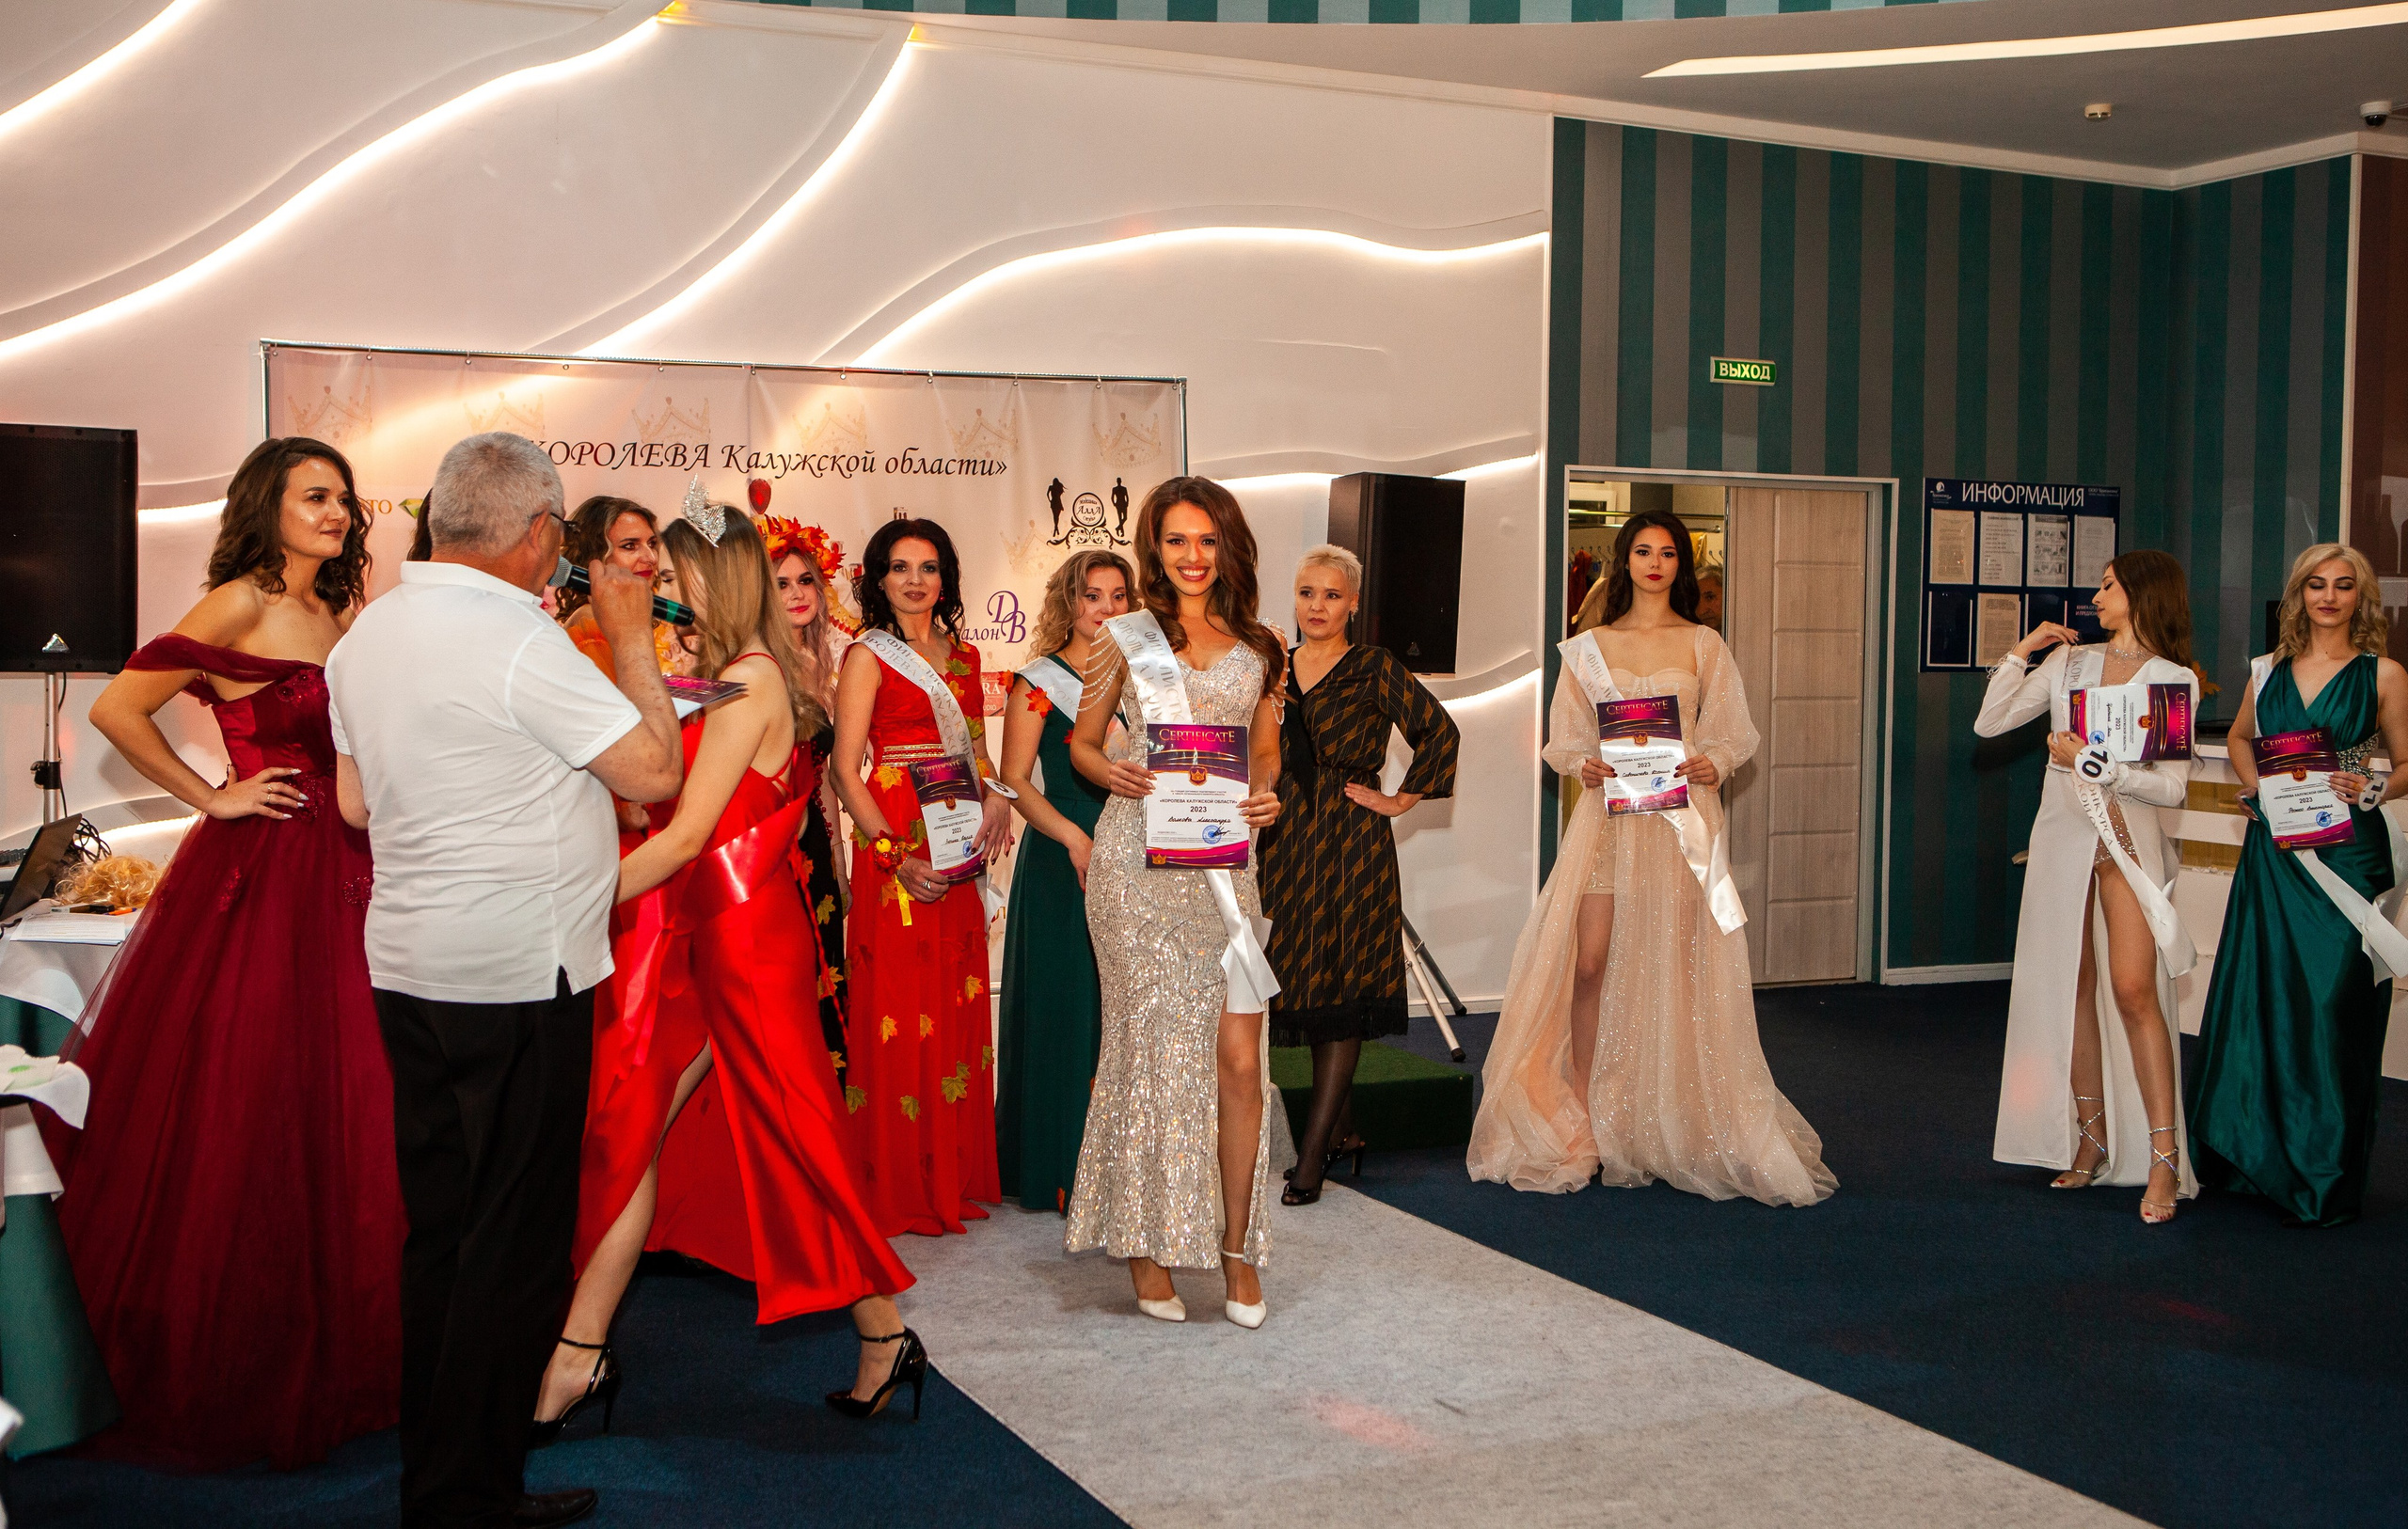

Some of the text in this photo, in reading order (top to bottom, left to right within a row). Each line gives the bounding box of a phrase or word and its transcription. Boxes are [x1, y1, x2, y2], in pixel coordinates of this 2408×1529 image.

[1719, 362, 1770, 381] ВЫХОД
[530, 440, 1007, 479] ОРОЛЕВА Калужской области»
[362, 499, 392, 514] ТО
[1962, 482, 2084, 510] ИНФОРМАЦИЯ
[960, 628, 1000, 640] алон
[2068, 660, 2083, 687] КОРО
[919, 675, 958, 755] КАЛУЖСКО
[1607, 700, 1668, 715] CERTIFICATE
[2175, 692, 2187, 751] CERTIFICATE
[1159, 729, 1235, 743] CERTIFICATE
[2261, 731, 2323, 750] CERTIFICATE
[2082, 750, 2109, 778] 10
[2088, 783, 2113, 846] ОНКУРСА
